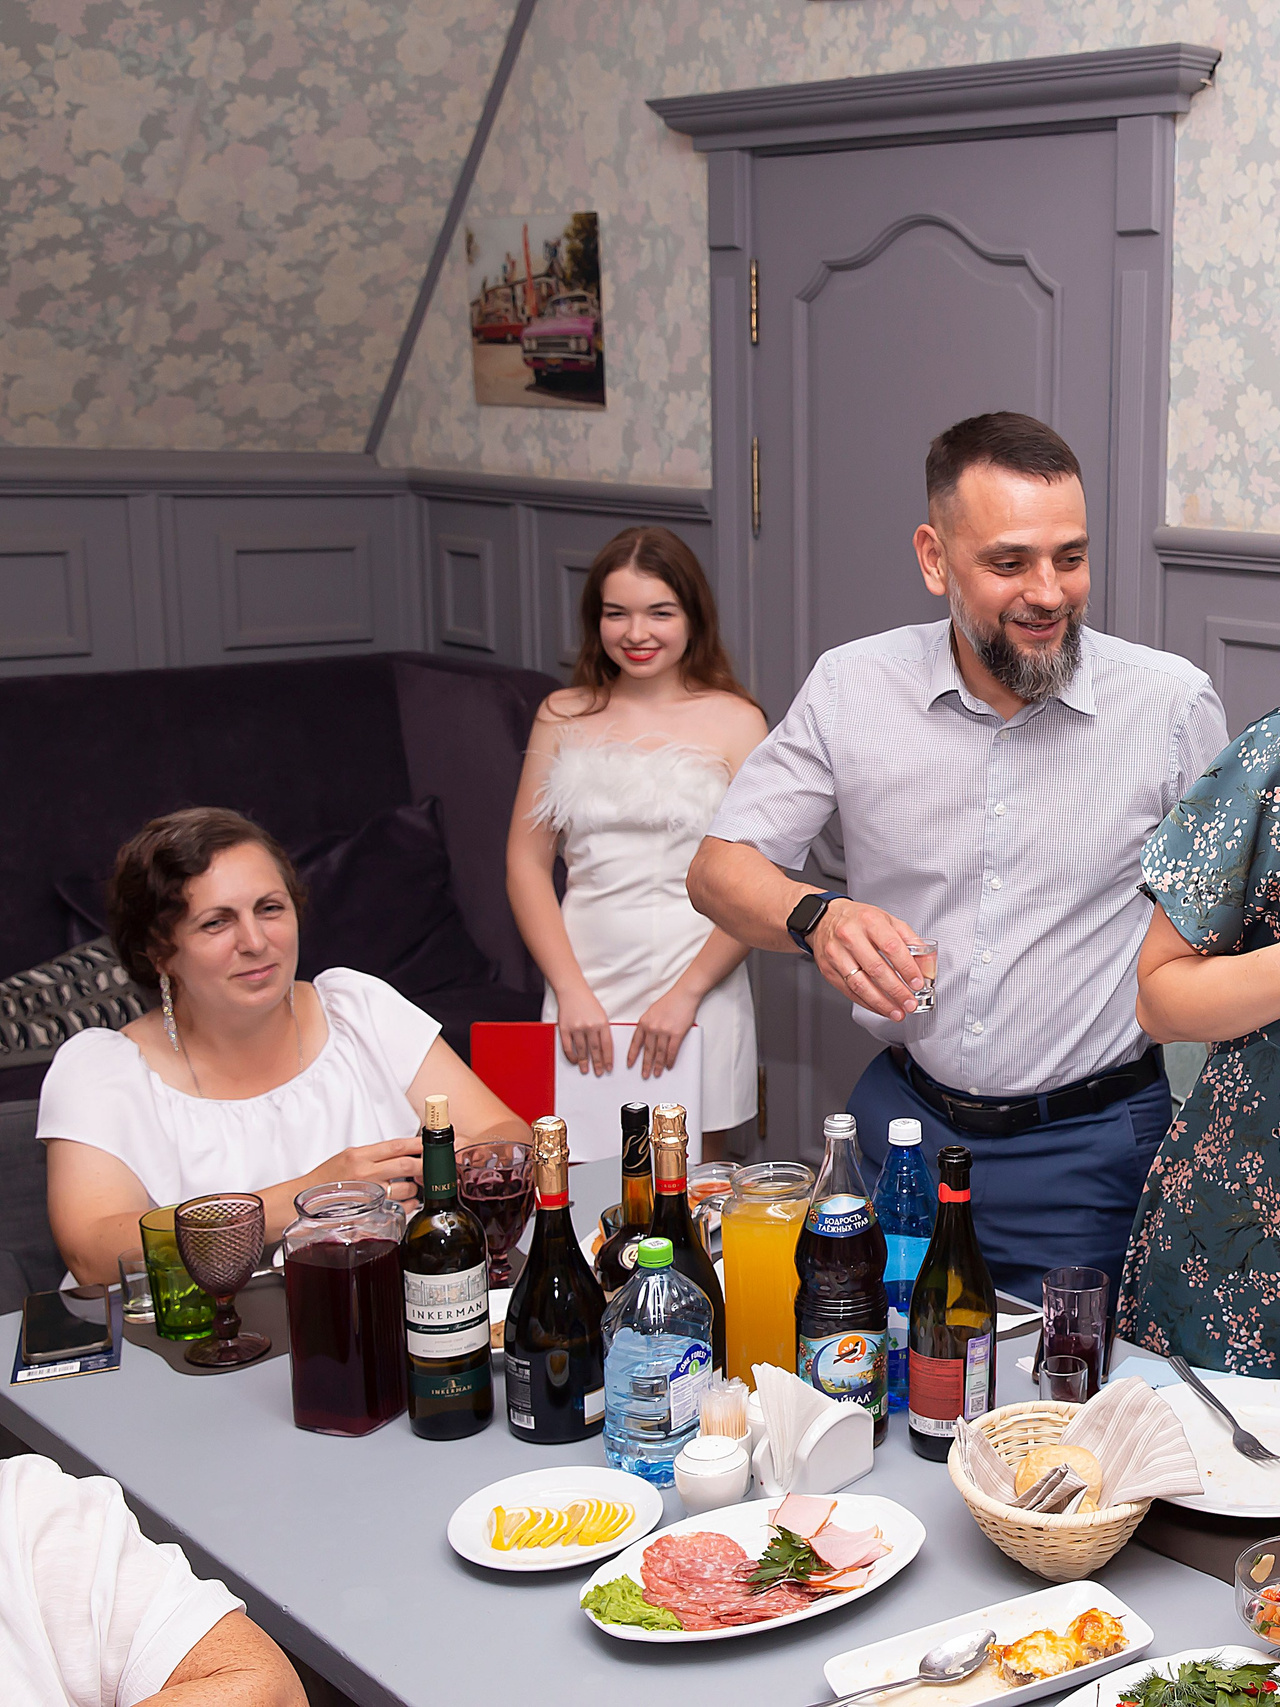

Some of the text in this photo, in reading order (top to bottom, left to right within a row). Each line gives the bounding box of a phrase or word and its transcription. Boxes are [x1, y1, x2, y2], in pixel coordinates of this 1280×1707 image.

[818, 1217, 869, 1233] ТАЁЖНЫХ ТРАВ
[824, 1213, 862, 1226] БОДРОСТЬ
[412, 1301, 482, 1320] INKERMAN
[431, 1384, 472, 1395] INKERMAN
